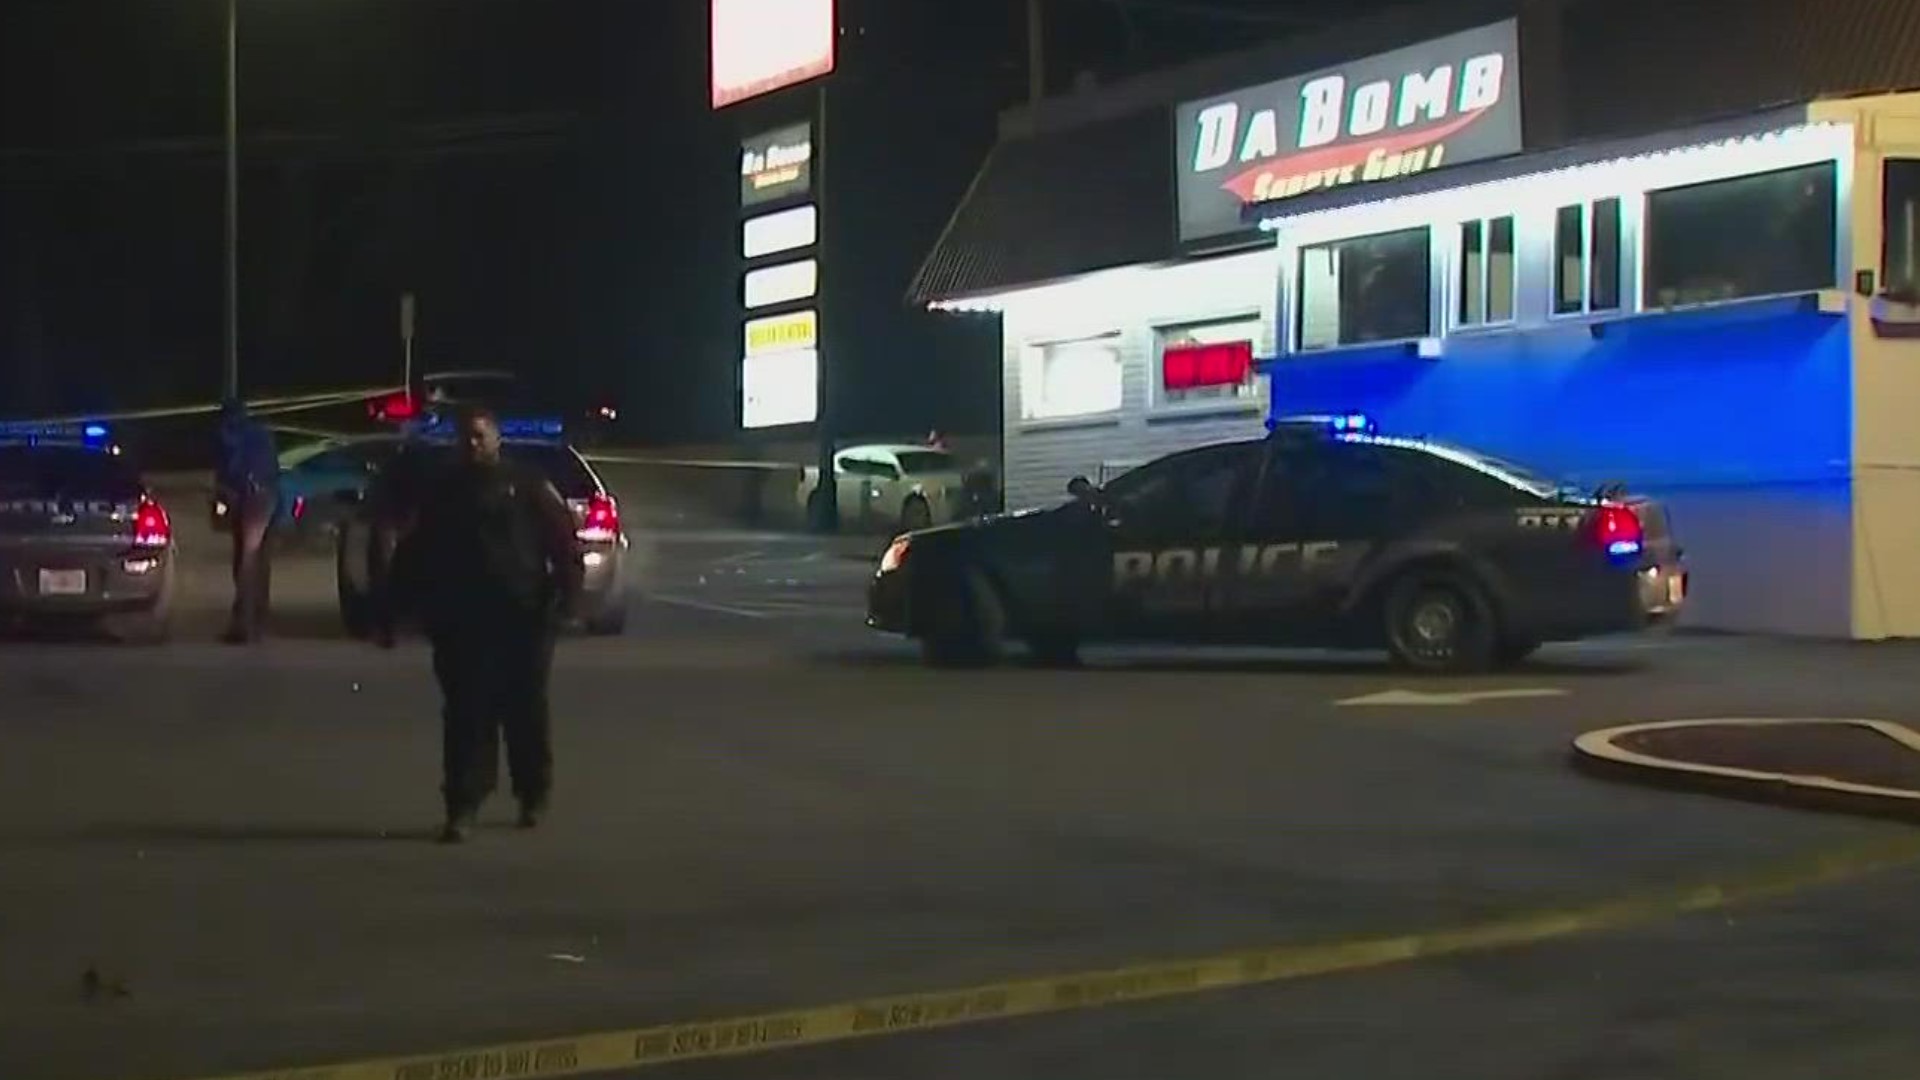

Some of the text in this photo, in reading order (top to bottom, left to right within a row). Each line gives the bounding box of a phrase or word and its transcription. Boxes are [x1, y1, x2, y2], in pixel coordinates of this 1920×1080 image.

[1194, 53, 1505, 172] DA BOMB
[1112, 541, 1339, 584] POLICE
